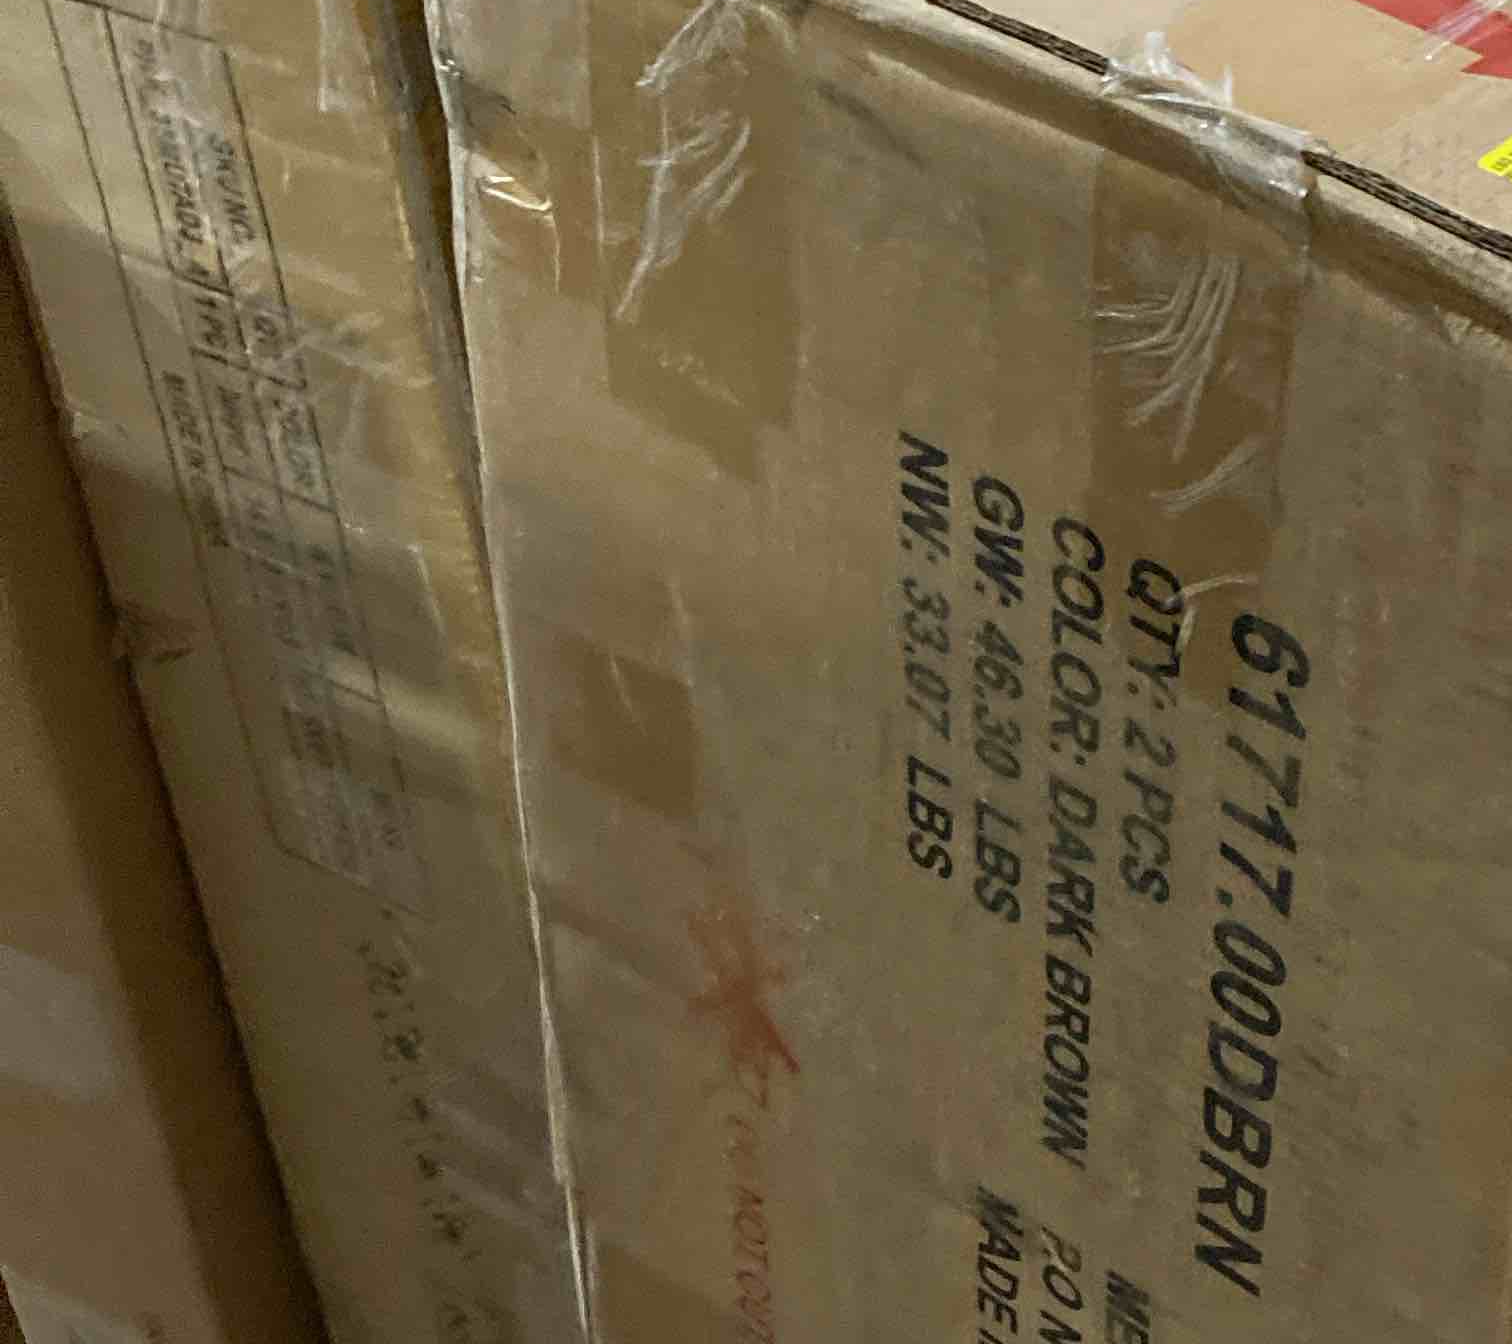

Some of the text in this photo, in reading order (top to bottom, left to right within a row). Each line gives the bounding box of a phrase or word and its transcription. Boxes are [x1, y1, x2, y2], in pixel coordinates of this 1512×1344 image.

[902, 576, 952, 744] 33.07
[1119, 558, 1185, 905] QTY: 2 PCS
[905, 754, 953, 881] LBS
[972, 797, 1022, 924] LBS
[1040, 516, 1107, 1171] COLOR: DARK BROWN
[1194, 613, 1312, 1299] 61717.00DBRN
[976, 1185, 1025, 1336] MADE
